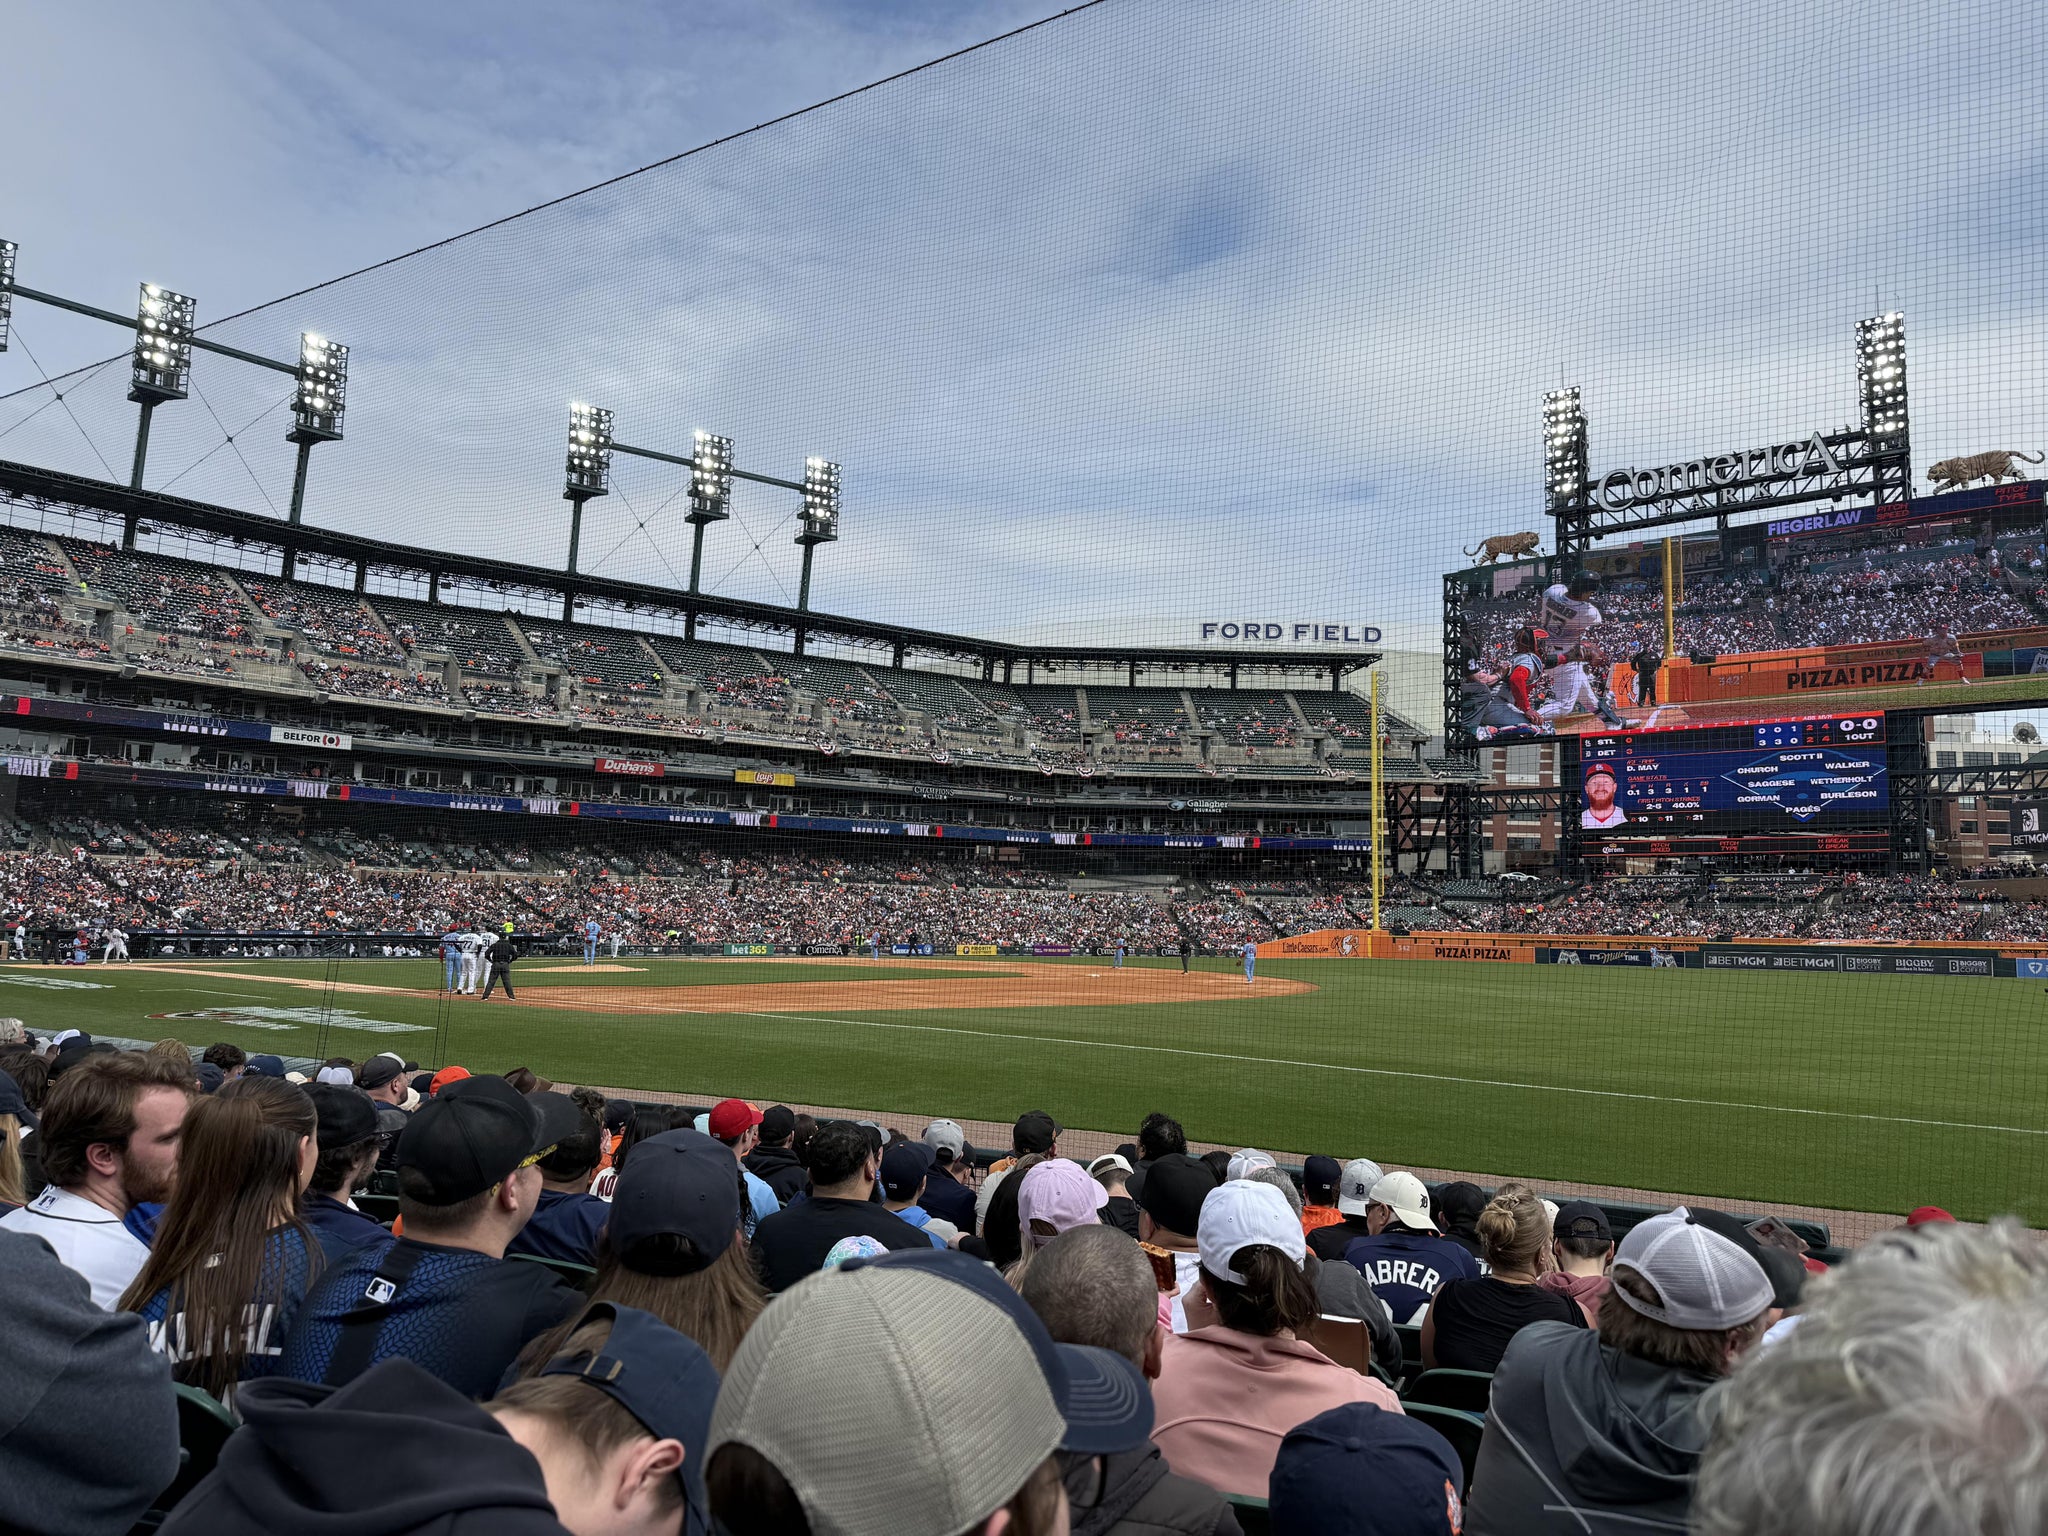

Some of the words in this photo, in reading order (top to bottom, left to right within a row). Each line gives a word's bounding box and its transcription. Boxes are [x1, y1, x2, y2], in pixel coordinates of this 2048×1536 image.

[1660, 482, 1772, 515] PARK
[1877, 503, 1908, 512] PITCH
[1876, 510, 1909, 520] SPEED
[1202, 623, 1283, 640] FORD
[1294, 624, 1383, 643] FIELD
[1787, 668, 1856, 690] PIZZA!
[1376, 685, 1389, 739] Rocket
[283, 732, 321, 744] BELFOR
[1597, 738, 1616, 746] STL
[1779, 753, 1815, 761] SCOTT
[603, 759, 656, 773] Dunham's
[1737, 766, 1778, 774] CHURCH
[1825, 761, 1870, 769] WALKER
[756, 772, 774, 783] Lay's
[1810, 776, 1874, 785] WETHERHOLT
[914, 786, 954, 797] CHAMPIONS
[1820, 791, 1877, 799] BURLESON
[1737, 794, 1781, 803] GORMAN
[1187, 799, 1230, 809] Gallagher
[2013, 833, 2048, 846] BETMGM
[463, 940, 473, 949] 77
[731, 945, 767, 955] bet365
[1435, 947, 1471, 959] PIZZA!
[1473, 948, 1511, 960] PIZZA!
[1600, 951, 1629, 963] Miller
[1718, 956, 1766, 966] BETMGM
[1783, 957, 1835, 967] BETMGM
[1357, 1259, 1440, 1296] ABRER
